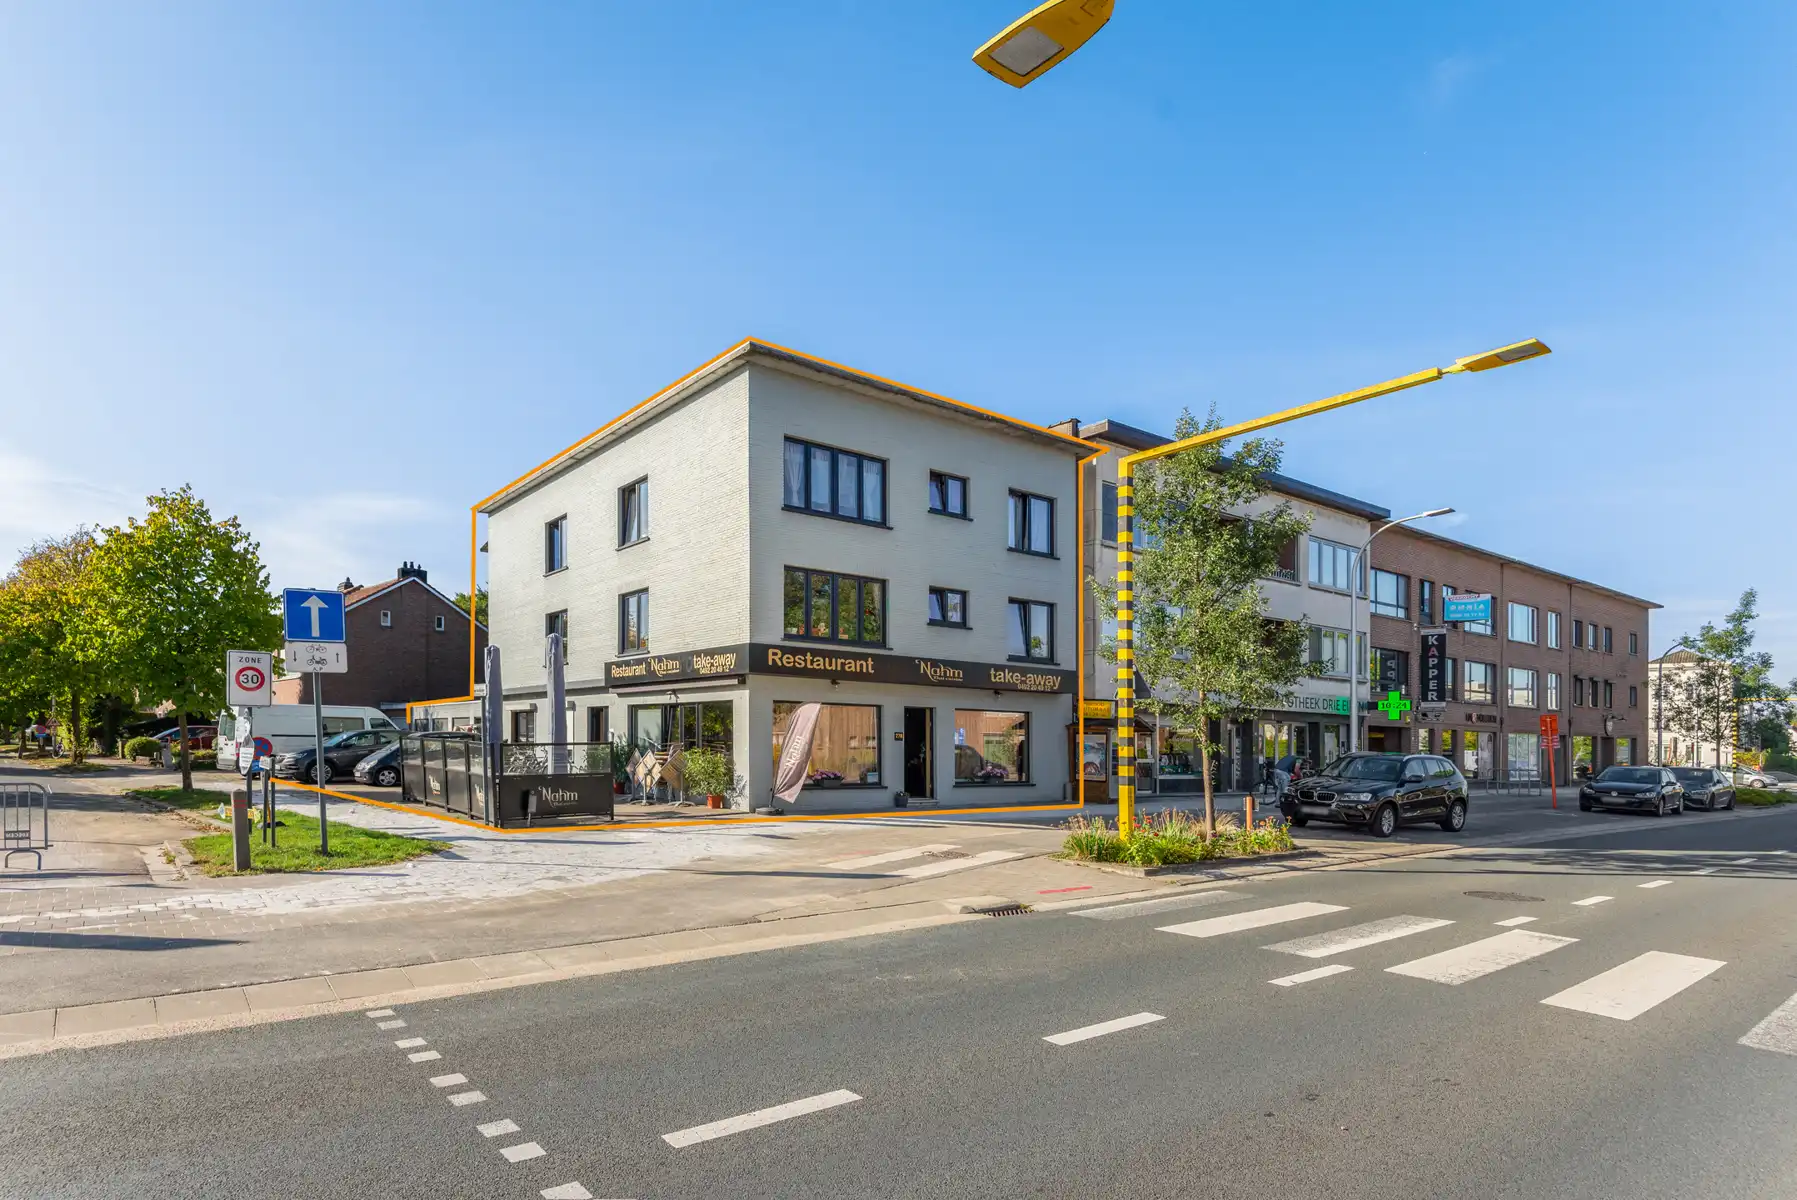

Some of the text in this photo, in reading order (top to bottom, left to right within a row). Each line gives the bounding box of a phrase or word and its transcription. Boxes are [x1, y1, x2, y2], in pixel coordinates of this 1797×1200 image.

[238, 656, 262, 664] ZONE
[611, 662, 646, 678] Restaurant
[648, 657, 680, 677] Nahm
[693, 653, 736, 669] take-away
[767, 648, 875, 674] Restaurant
[1428, 635, 1438, 701] KAPPER
[241, 673, 260, 685] 30
[915, 659, 963, 682] Nahm
[989, 667, 1061, 689] take-away
[1322, 698, 1340, 710] DRIE
[538, 786, 578, 808] Nahm
